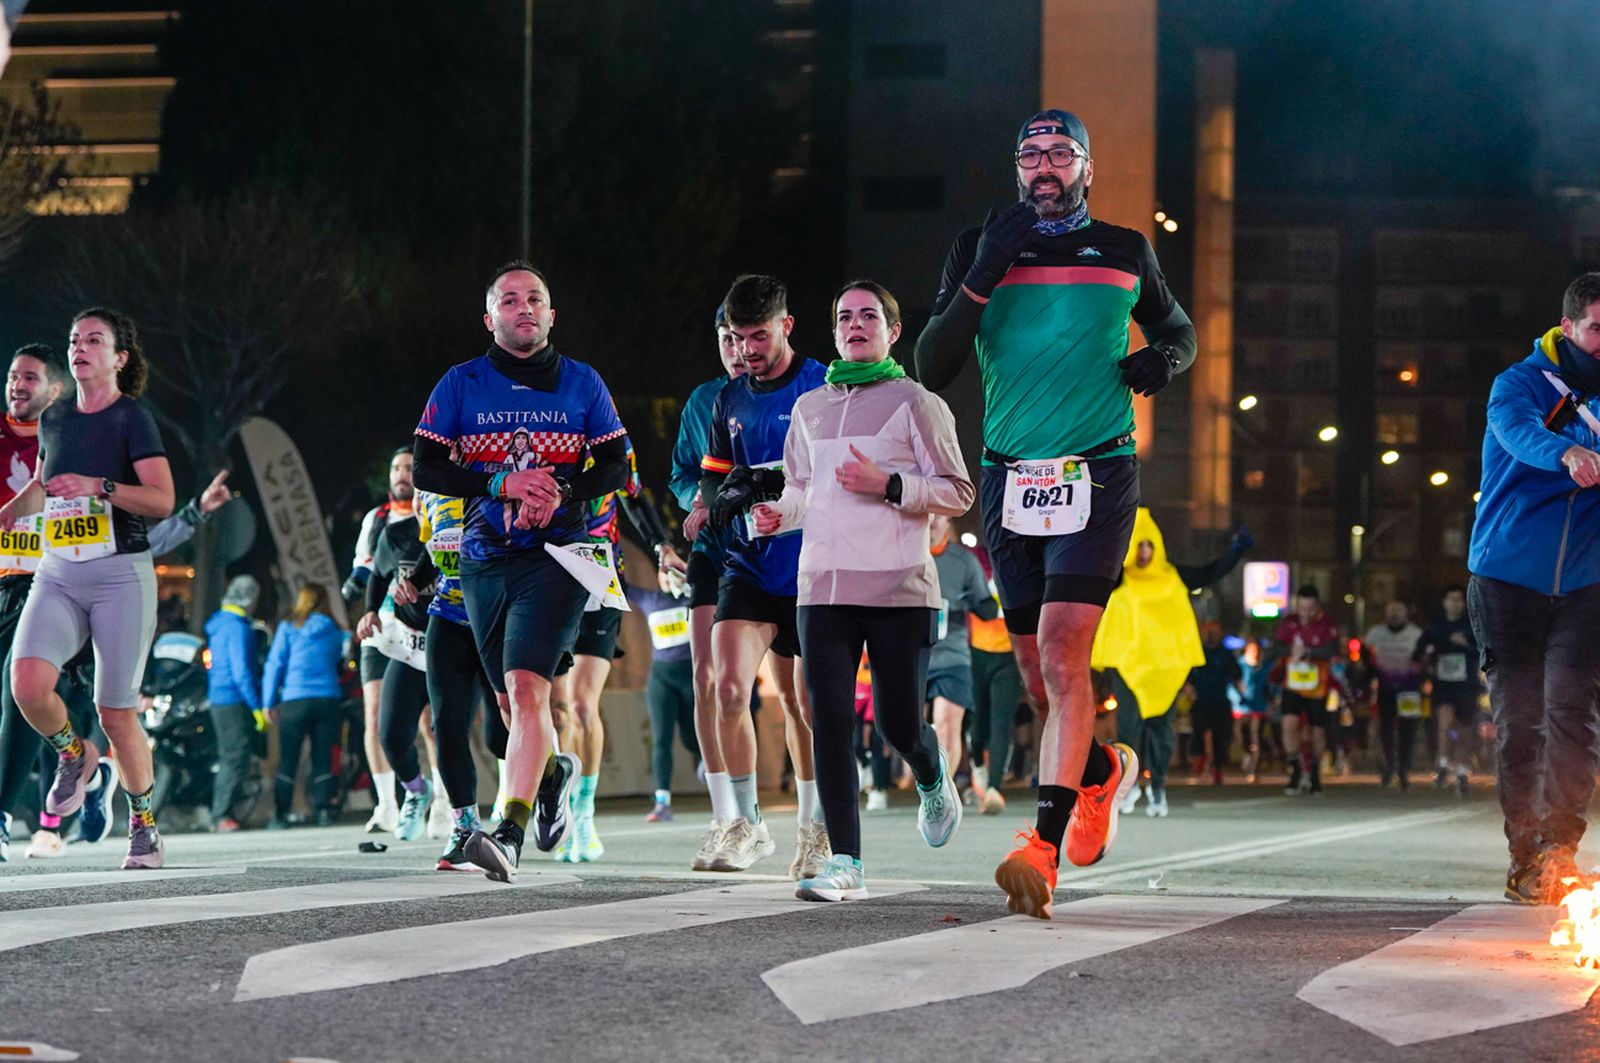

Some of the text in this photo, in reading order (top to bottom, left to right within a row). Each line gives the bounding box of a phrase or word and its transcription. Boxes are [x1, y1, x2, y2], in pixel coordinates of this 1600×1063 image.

[477, 411, 568, 425] BASTITANIA
[1045, 467, 1055, 475] DE
[1016, 477, 1057, 487] SAN ATON
[1022, 484, 1074, 509] 6827
[54, 516, 98, 540] 2469
[1, 532, 40, 551] 6100
[442, 551, 460, 570] 42
[409, 634, 426, 651] 38
